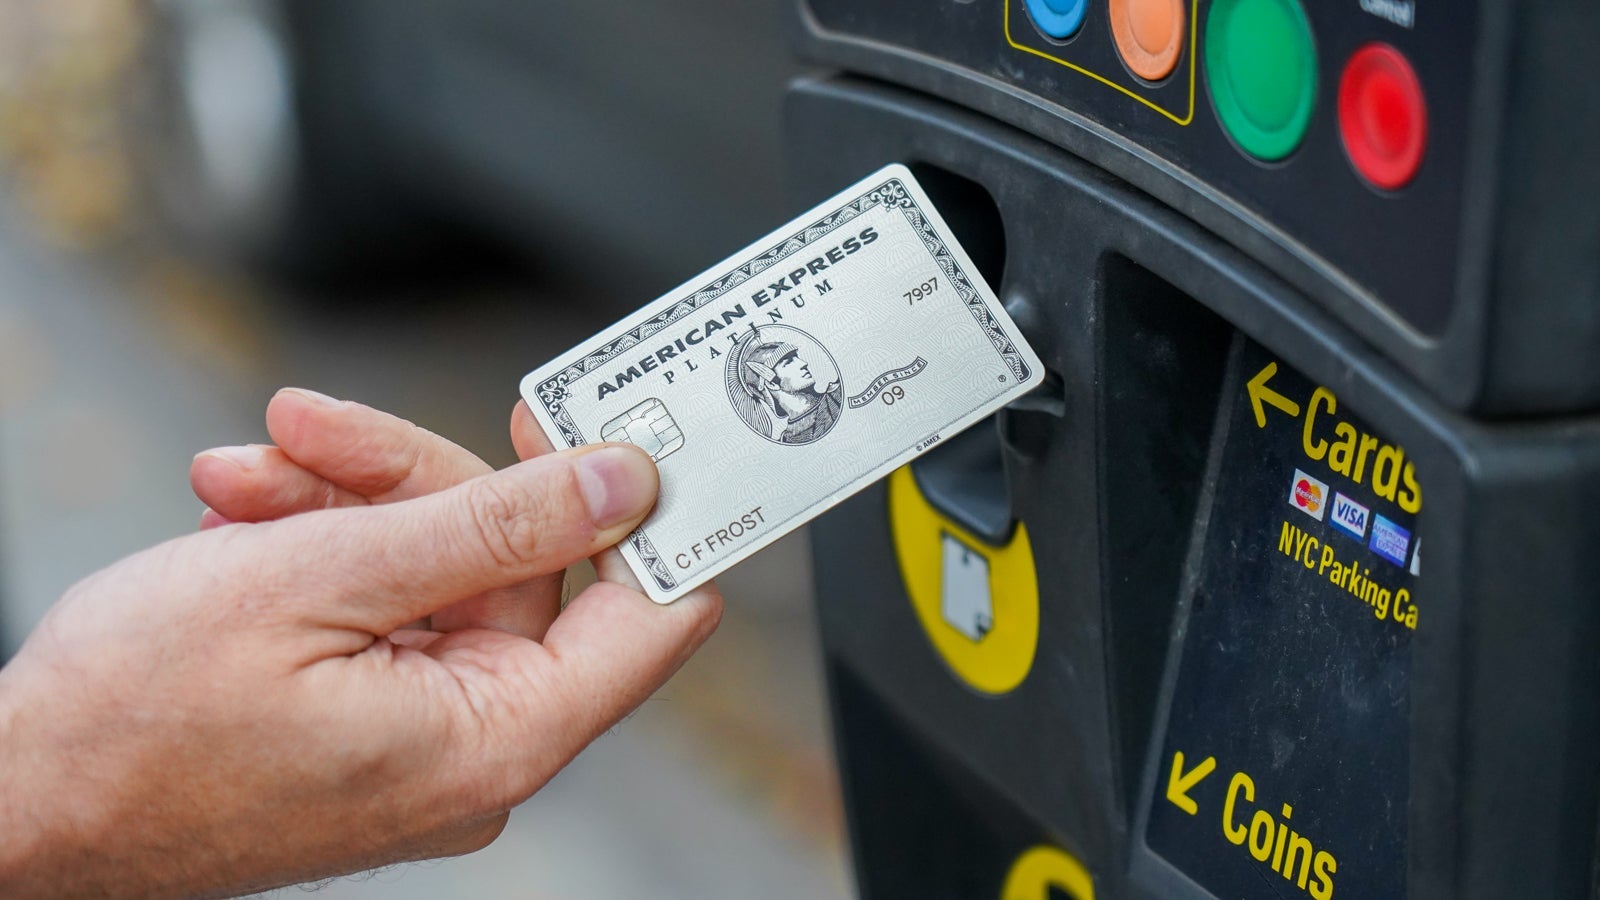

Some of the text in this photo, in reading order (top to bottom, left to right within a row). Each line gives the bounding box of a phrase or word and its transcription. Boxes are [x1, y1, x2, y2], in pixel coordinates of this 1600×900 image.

[598, 226, 879, 400] AMERICAN EXPRESS
[903, 277, 939, 305] 7997
[663, 278, 832, 384] PLATINUM
[853, 361, 923, 404] MEMBER SINCE
[881, 385, 905, 405] 09
[923, 434, 942, 449] AMEX
[1303, 386, 1422, 514] Cards
[675, 506, 765, 569] C F FROST
[1337, 500, 1364, 531] VISA
[1278, 520, 1319, 569] NYC
[1318, 544, 1391, 620] Parking
[1223, 771, 1337, 900] Coins
